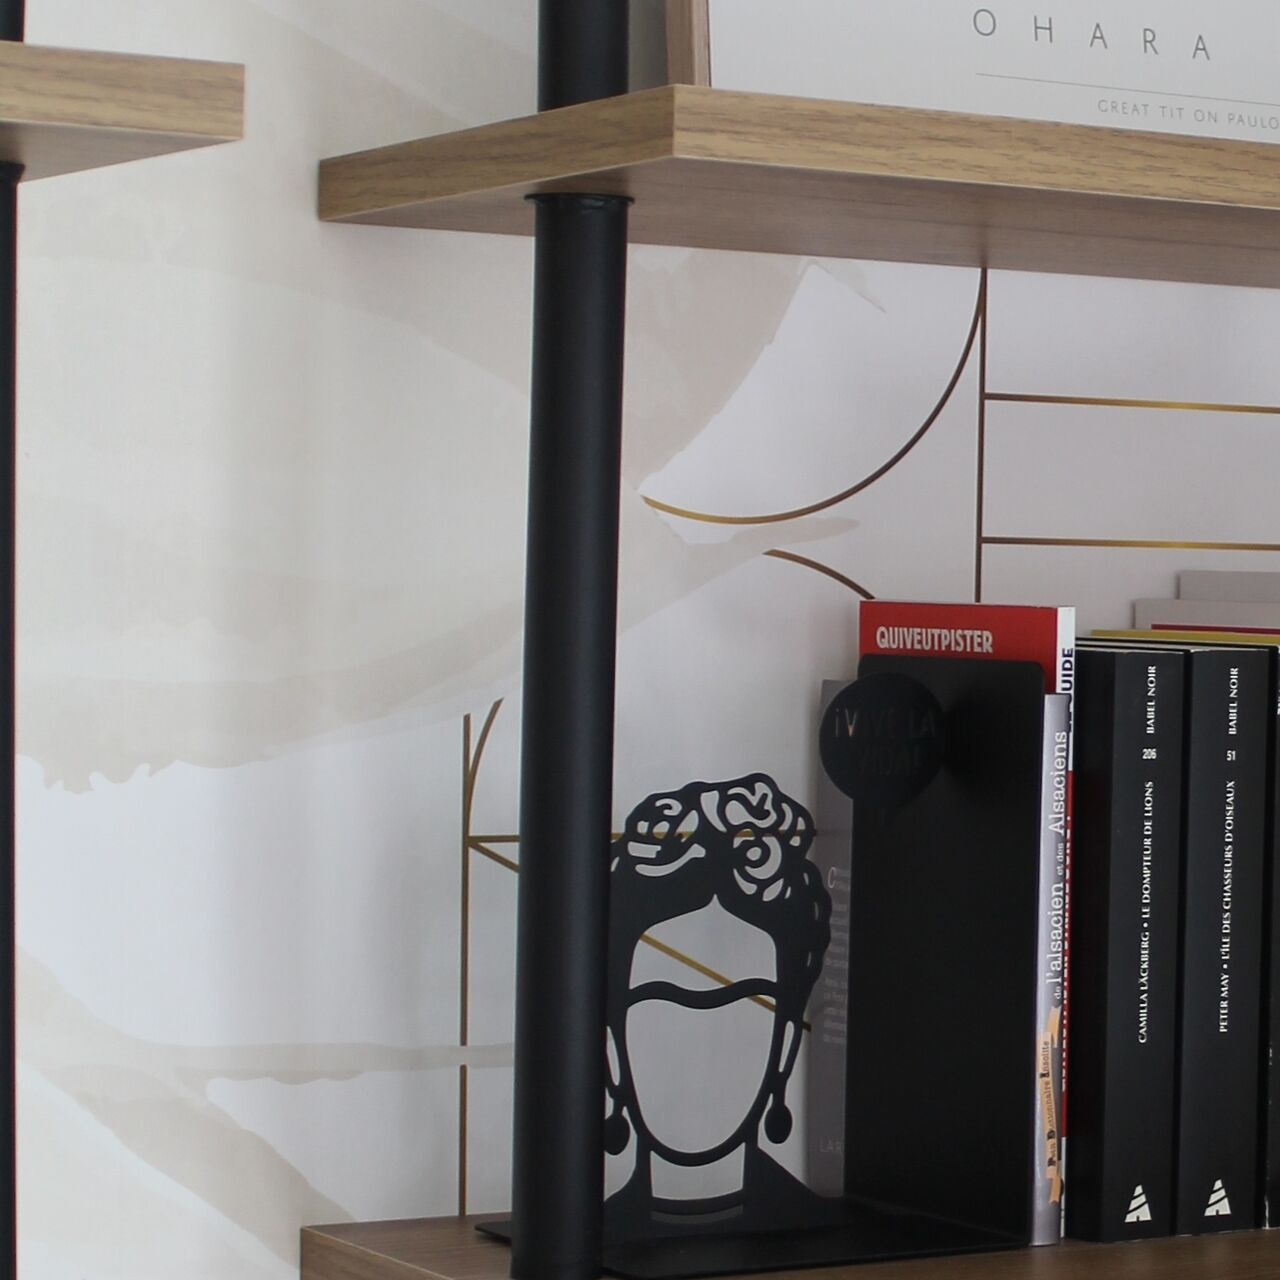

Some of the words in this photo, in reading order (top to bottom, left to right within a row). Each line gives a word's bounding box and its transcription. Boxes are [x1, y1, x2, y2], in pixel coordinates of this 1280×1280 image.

[973, 8, 1210, 61] OHARA
[1097, 99, 1149, 116] GREAT
[1159, 106, 1185, 120] TIT
[1194, 109, 1218, 124] ON
[876, 626, 993, 654] QUIVEUTPISTER
[1147, 665, 1157, 696] NOIR
[1229, 667, 1239, 697] NOIR
[1146, 700, 1156, 734] BABEL
[1228, 701, 1238, 735] BABEL
[1226, 750, 1236, 761] 51
[1048, 731, 1068, 836] Alsaciens
[1144, 781, 1154, 816] LIONS
[1143, 820, 1153, 835] DE
[1224, 780, 1235, 842] D'OISEAUX
[1056, 864, 1064, 876] et
[1141, 838, 1152, 904] DOMPTEUR
[1222, 844, 1233, 910] CHASSEURS
[1141, 906, 1150, 919] LE
[1221, 912, 1231, 933] DES
[1046, 882, 1063, 984] l'alsacien
[1138, 931, 1150, 990] LÄCKBERG
[1054, 986, 1062, 1000] de
[1220, 972, 1230, 998] MAY
[1138, 993, 1148, 1044] CAMILLA
[1219, 1000, 1229, 1033] PETER
